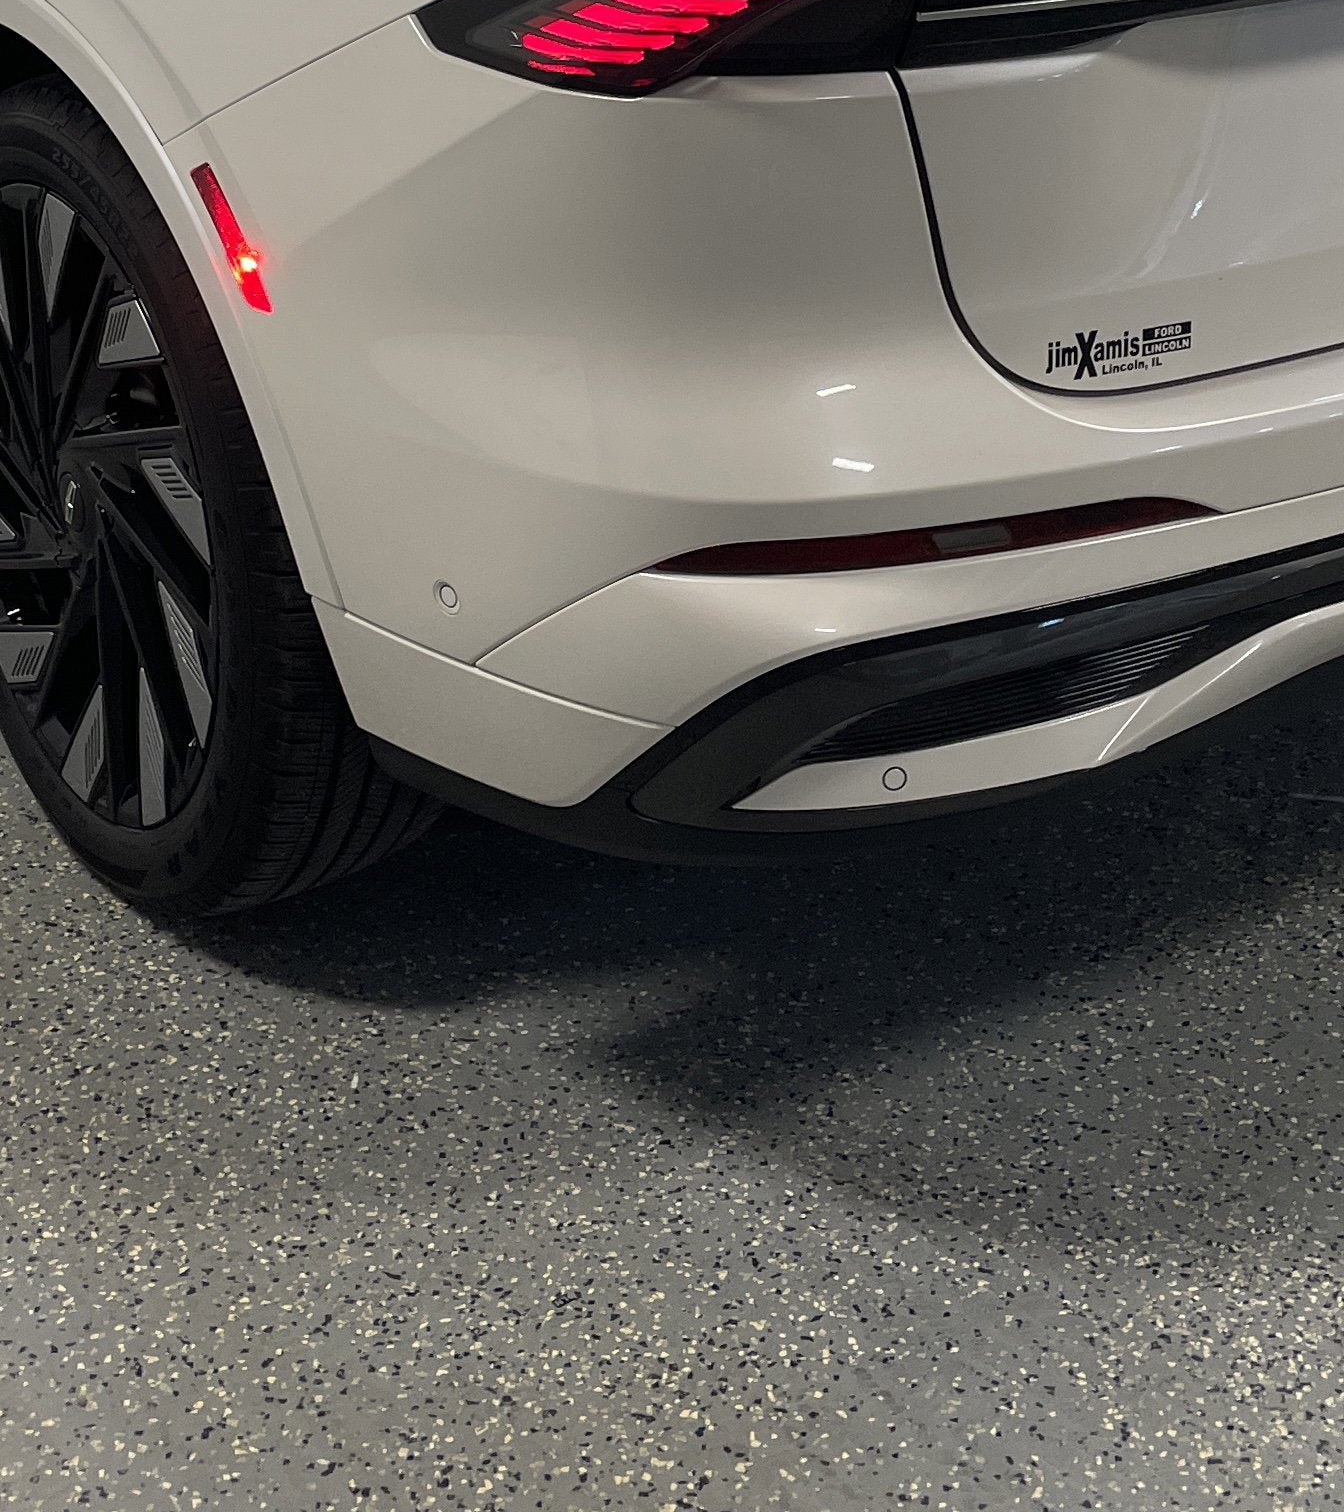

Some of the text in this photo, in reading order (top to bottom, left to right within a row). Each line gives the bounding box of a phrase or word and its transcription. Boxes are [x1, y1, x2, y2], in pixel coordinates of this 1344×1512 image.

[1154, 324, 1182, 338] FORD
[1144, 338, 1190, 356] LINCOLN
[1102, 357, 1163, 376] Lincoln, IL
